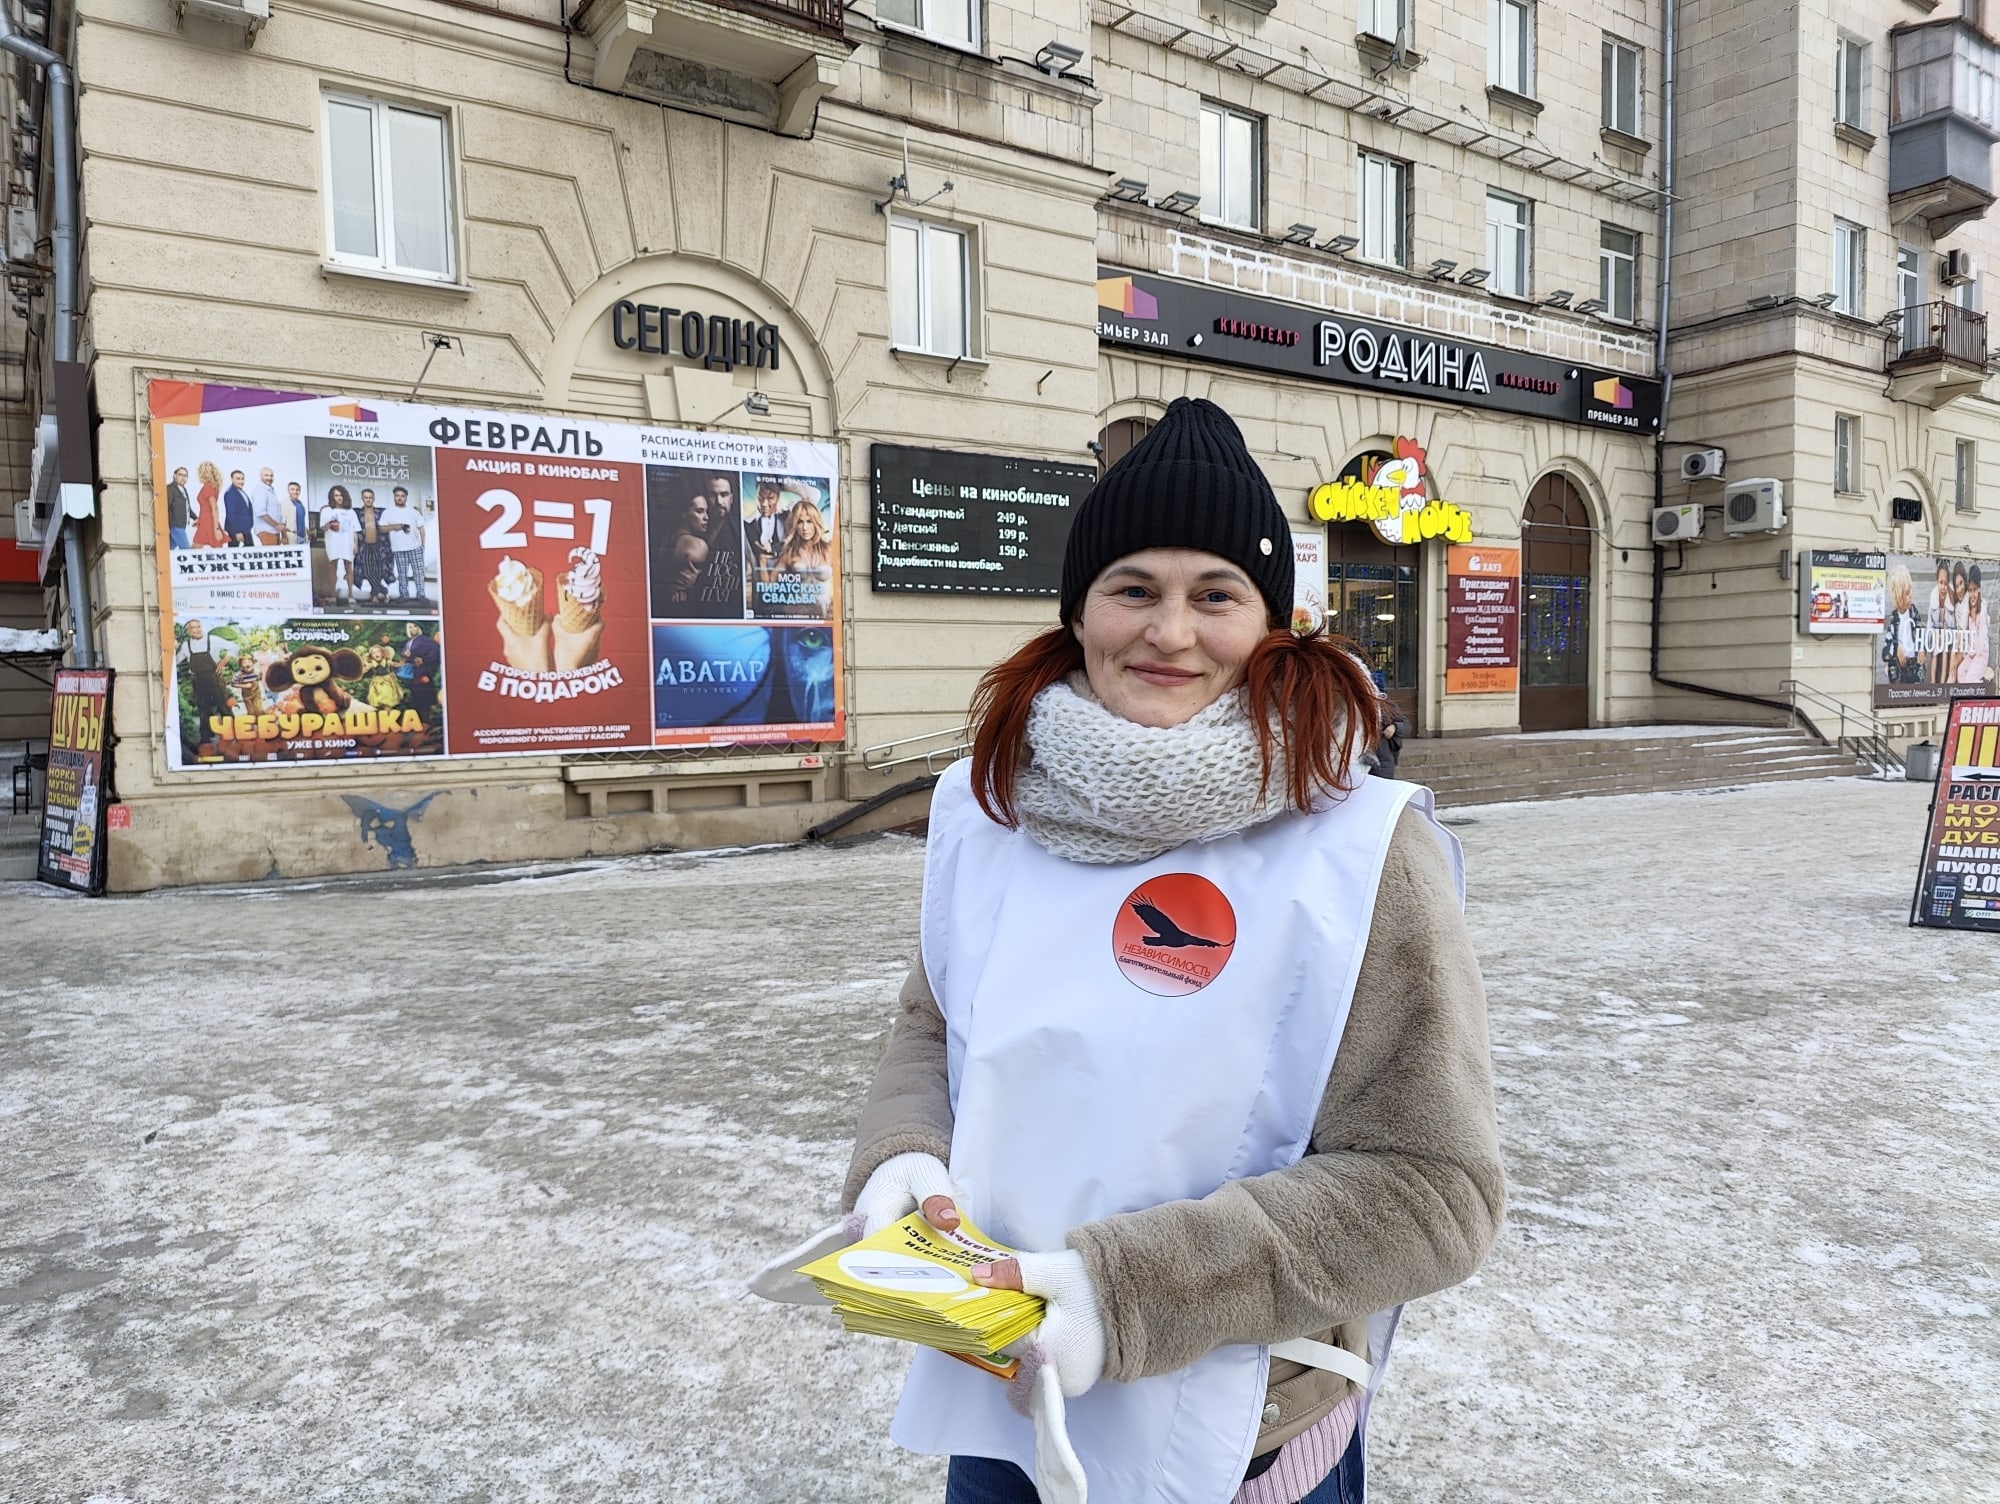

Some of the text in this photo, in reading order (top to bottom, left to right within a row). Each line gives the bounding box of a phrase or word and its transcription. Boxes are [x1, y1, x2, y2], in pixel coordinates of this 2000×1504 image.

[613, 300, 779, 372] СЕГОДНЯ
[1143, 330, 1169, 346] ЗАЛ
[1218, 317, 1301, 346] КИНОТЕАТР
[1317, 320, 1491, 394] РОДИНА
[1502, 372, 1562, 395] КИНОТЕАТР
[1587, 409, 1639, 428] ПРЕМЬЕР ЗАЛ
[329, 429, 380, 439] РОДИНА
[429, 417, 604, 457] ФЕВРАЛЬ
[641, 434, 764, 454] РАСПИСАНИЕ СМОТРИ
[329, 449, 409, 467] СВОБОДНЫЕ
[642, 449, 764, 468] В НАШЕЙ ГРУППЕ В ВК
[330, 463, 410, 480] ОТНОШЕНИЯ
[466, 458, 619, 482] АКЦИЯ В КИНОБАРЕ
[912, 478, 1070, 507] Цены на кинобилеты
[1308, 476, 1401, 522] CHICKEN
[475, 488, 613, 556] 2=1
[892, 503, 965, 520] Стандартный
[1017, 513, 1028, 526] р.
[1402, 500, 1473, 544] HOUSE
[892, 521, 938, 535] Детский
[998, 528, 1017, 540] 199
[1018, 530, 1029, 543] р.
[879, 538, 891, 550] 3.
[998, 545, 1017, 557] 150
[1018, 547, 1029, 559] р.
[1295, 542, 1318, 551] ЧИКЕН
[176, 555, 188, 563] О
[229, 550, 304, 560] ГОВОРЯТ
[879, 554, 945, 568] Подробности
[945, 559, 957, 569] на
[1295, 552, 1318, 563] ХАУЗ
[1865, 555, 1885, 569] СКОРО
[179, 559, 305, 574] МУЖЧИНЫ
[778, 573, 801, 583] МОЯ
[1460, 577, 1510, 591] Приглашаем
[216, 590, 234, 598] КИНО
[236, 590, 241, 598] С
[248, 591, 280, 599] ФЕВРАЛЯ
[756, 582, 823, 593] ПИРАТСКАЯ
[1465, 590, 1505, 603] на работу
[762, 593, 816, 604] СВАДЬБА
[488, 658, 612, 682] ВТОРОЕ МОРОЖЕНОЕ
[477, 667, 624, 703] В ПОДАРОК!
[1888, 688, 1912, 698] Проспект
[52, 694, 106, 752] ШУБЫ
[209, 708, 424, 741] ЧЕБУРАШКА
[286, 738, 357, 750] УЖЕ В КИНО
[48, 767, 76, 780] НОРКА
[48, 779, 76, 793] МУТОН
[1944, 816, 2000, 828] МУ
[1123, 943, 1211, 978] НЕЗАВИСИМОСТЬ
[1184, 975, 1203, 988] фонд
[904, 1241, 972, 1268] сделали
